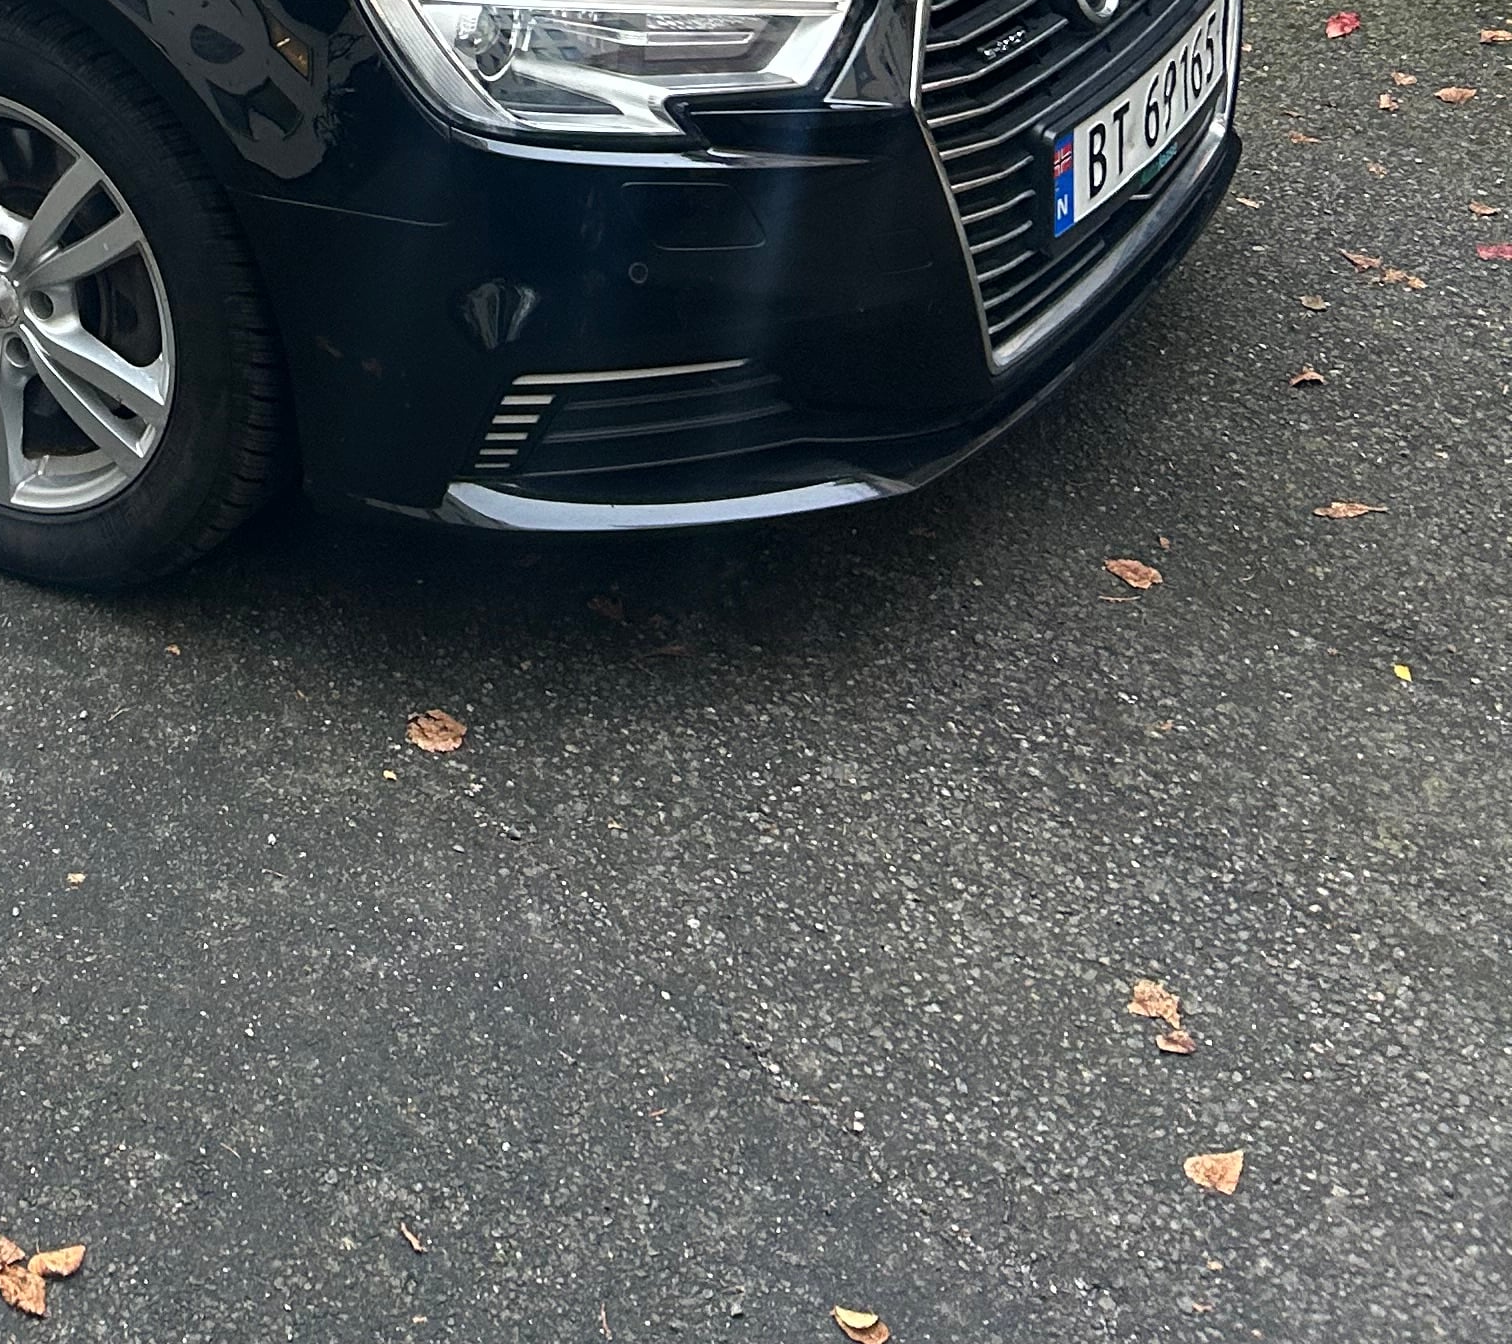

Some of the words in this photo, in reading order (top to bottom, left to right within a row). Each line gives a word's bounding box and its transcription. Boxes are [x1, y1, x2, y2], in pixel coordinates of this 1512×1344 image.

[1089, 98, 1130, 201] BT
[1144, 10, 1217, 149] 69165
[1056, 194, 1068, 220] N
